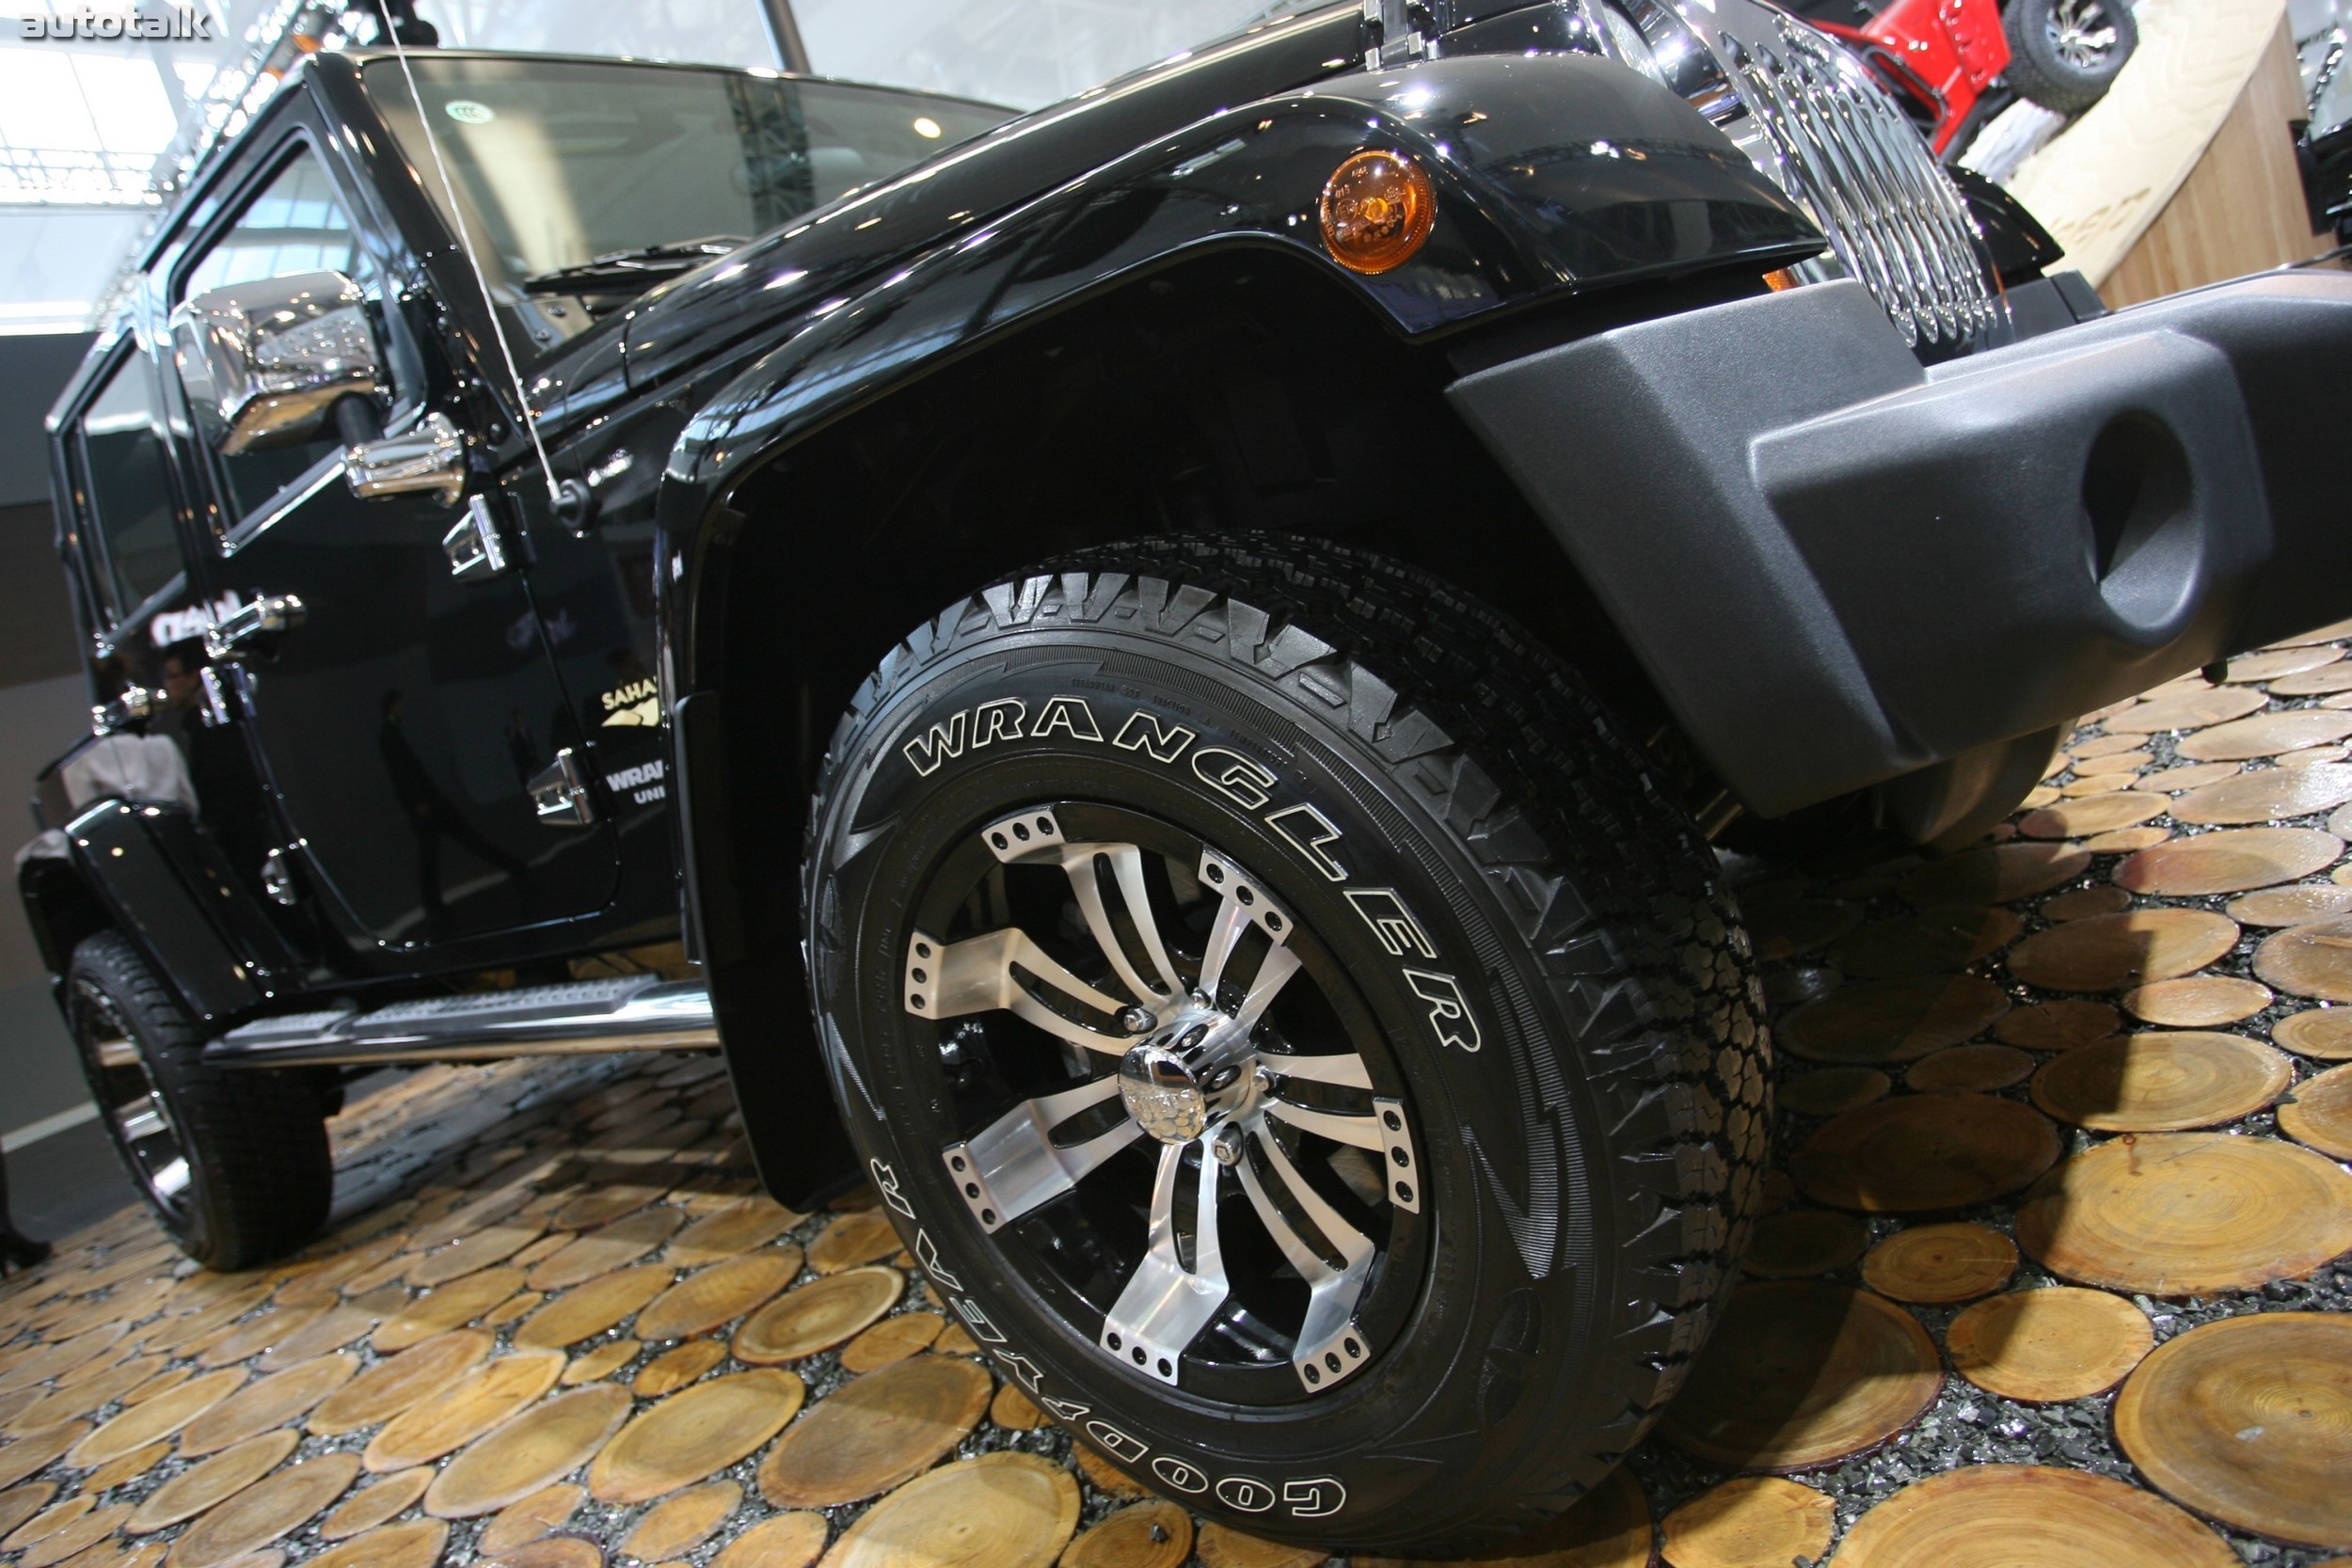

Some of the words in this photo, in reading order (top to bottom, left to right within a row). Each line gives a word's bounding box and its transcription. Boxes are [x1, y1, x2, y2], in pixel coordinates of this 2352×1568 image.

[601, 675, 658, 710] SAHA
[903, 695, 1481, 1053] WRANGLER
[870, 1158, 1346, 1516] GOODYEAR
